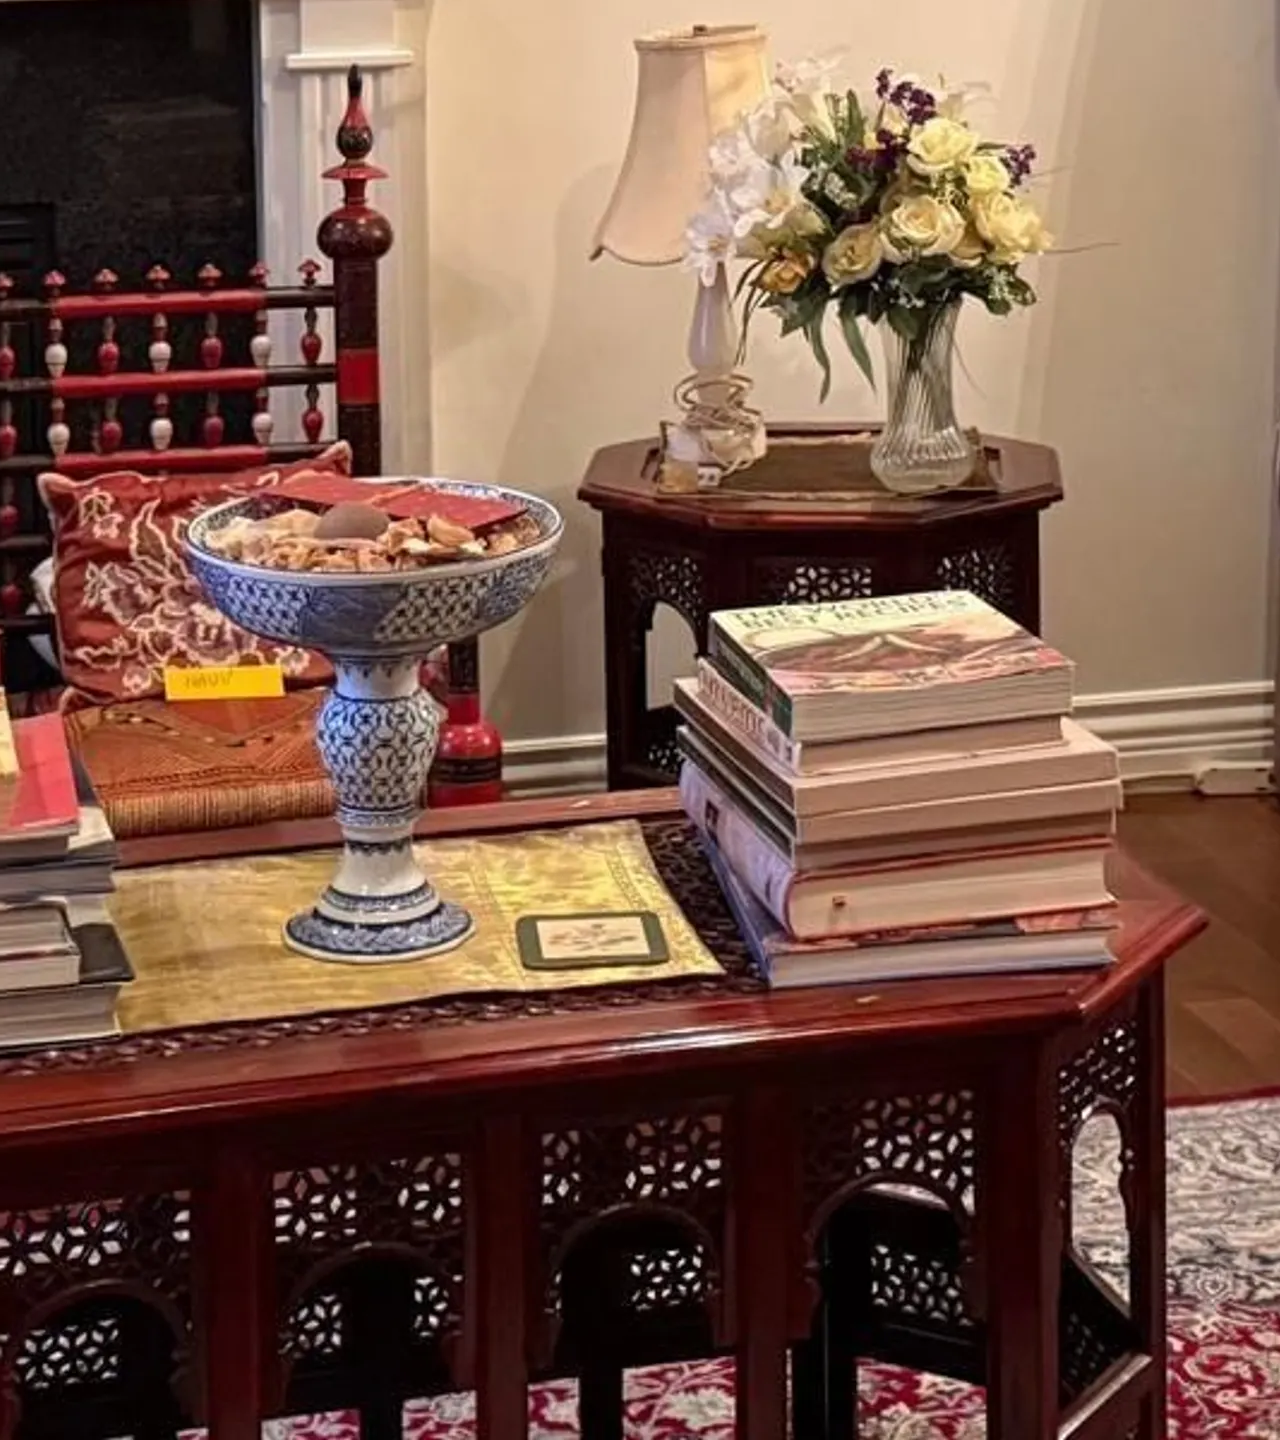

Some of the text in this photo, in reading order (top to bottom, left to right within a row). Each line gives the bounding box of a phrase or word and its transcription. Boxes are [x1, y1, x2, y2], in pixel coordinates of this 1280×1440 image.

[733, 608, 789, 624] THE
[742, 598, 968, 628] BEST RECIPES
